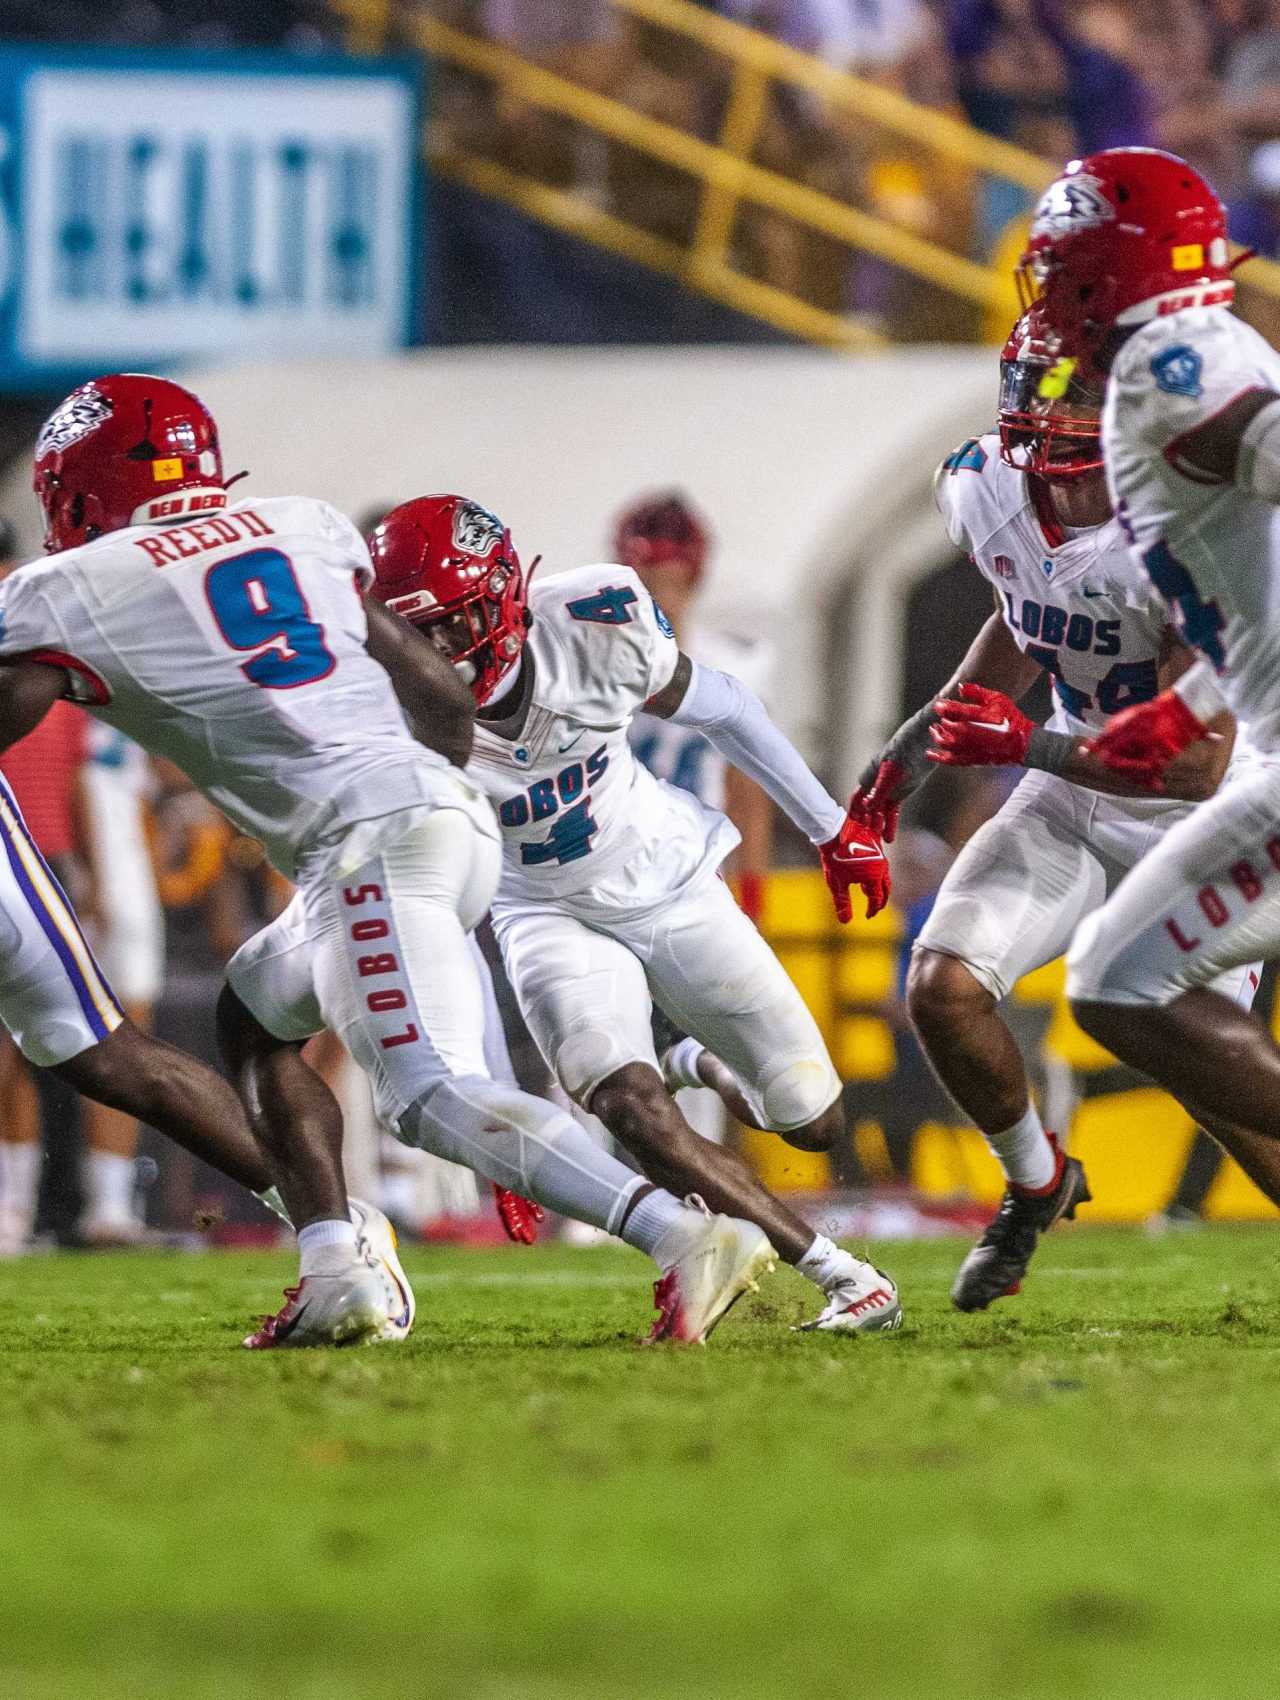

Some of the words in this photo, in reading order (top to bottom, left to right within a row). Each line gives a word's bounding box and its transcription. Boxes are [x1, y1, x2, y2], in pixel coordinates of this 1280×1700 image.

[56, 132, 384, 307] HEALTH
[134, 518, 241, 567] REED
[230, 511, 275, 537] II
[204, 547, 336, 688] 9
[565, 586, 638, 625] 4
[1000, 591, 1122, 657] LOBOS
[499, 743, 610, 828] OBOS
[520, 796, 599, 867] 4
[344, 882, 419, 1051] LOBOS
